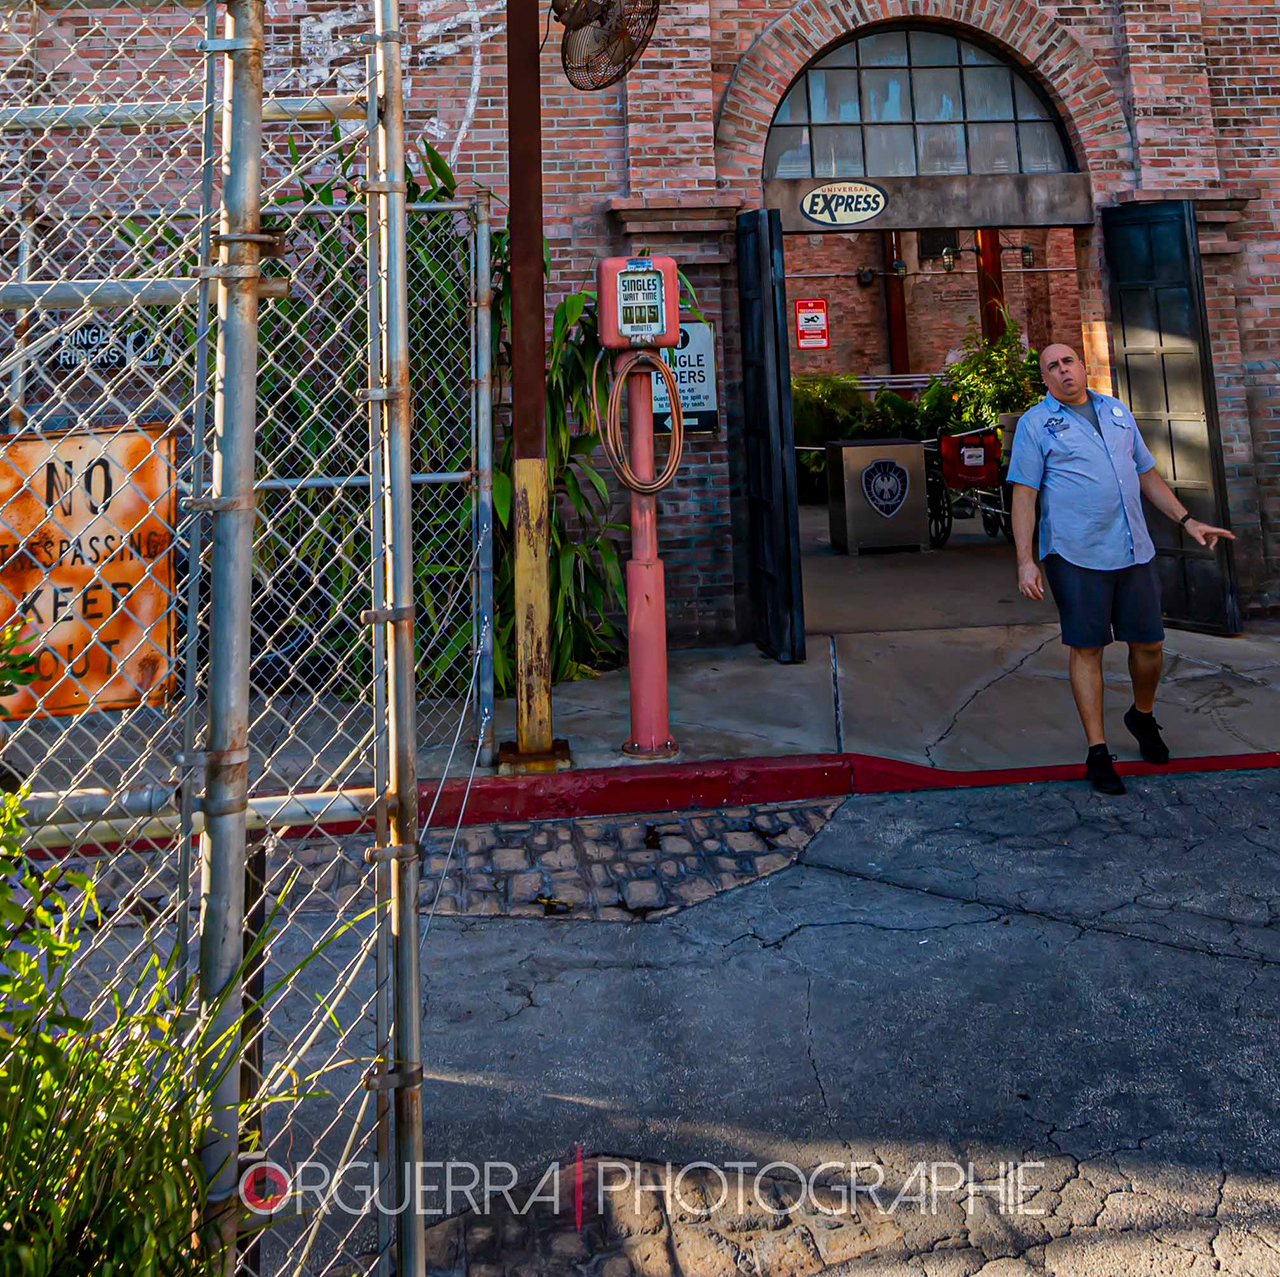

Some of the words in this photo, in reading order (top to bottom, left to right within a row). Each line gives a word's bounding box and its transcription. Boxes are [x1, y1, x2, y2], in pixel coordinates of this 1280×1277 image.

[808, 194, 881, 222] EXPRESS
[622, 279, 657, 292] SINGLES
[623, 292, 639, 301] WAIT
[642, 292, 657, 301] TIME
[664, 354, 705, 368] INGLE
[655, 370, 706, 385] RDERS
[45, 458, 113, 517] NO
[20, 582, 133, 625] KEEP
[35, 640, 119, 682] OUT
